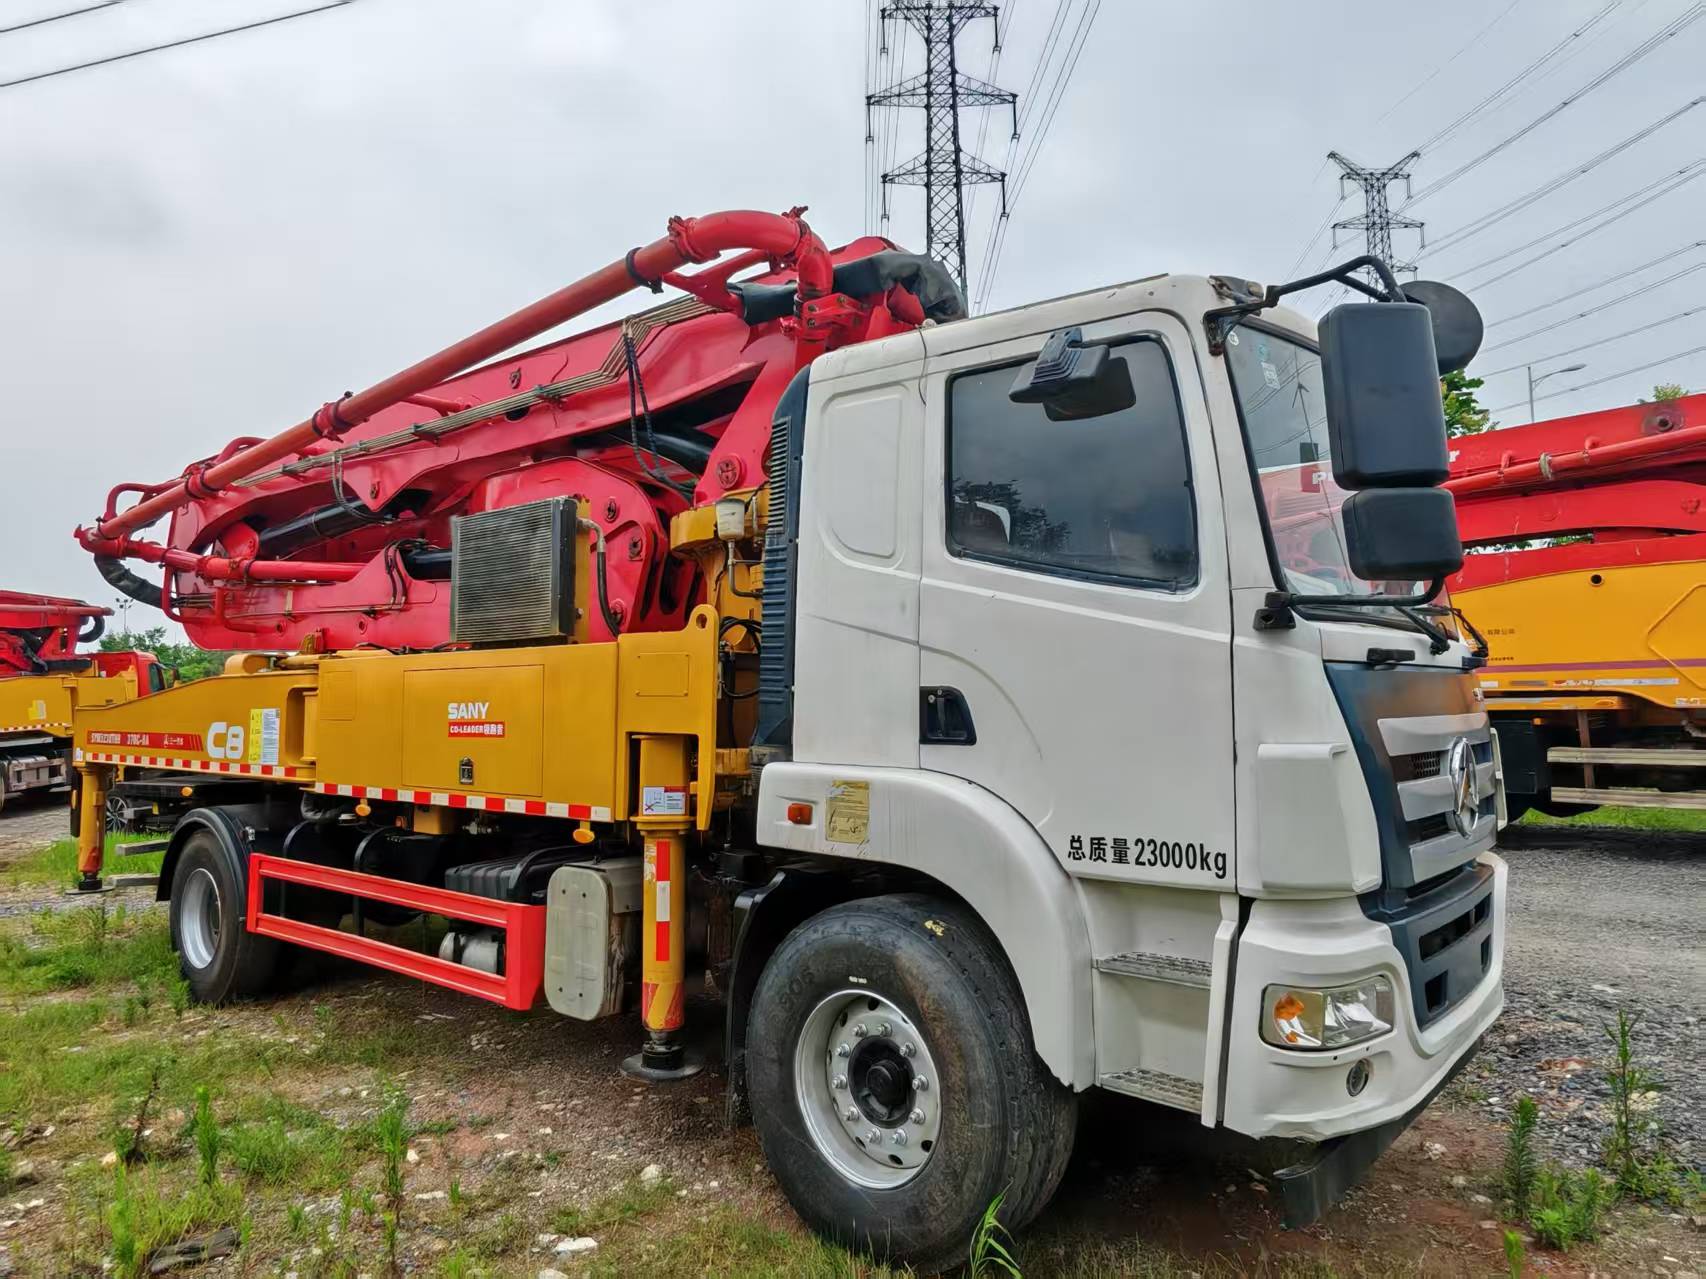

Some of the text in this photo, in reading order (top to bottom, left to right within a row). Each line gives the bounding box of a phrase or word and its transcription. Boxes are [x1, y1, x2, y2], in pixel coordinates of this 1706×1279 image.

[448, 702, 489, 720] SANY
[206, 721, 245, 760] C8
[1067, 834, 1228, 880] 总质量23000kg
